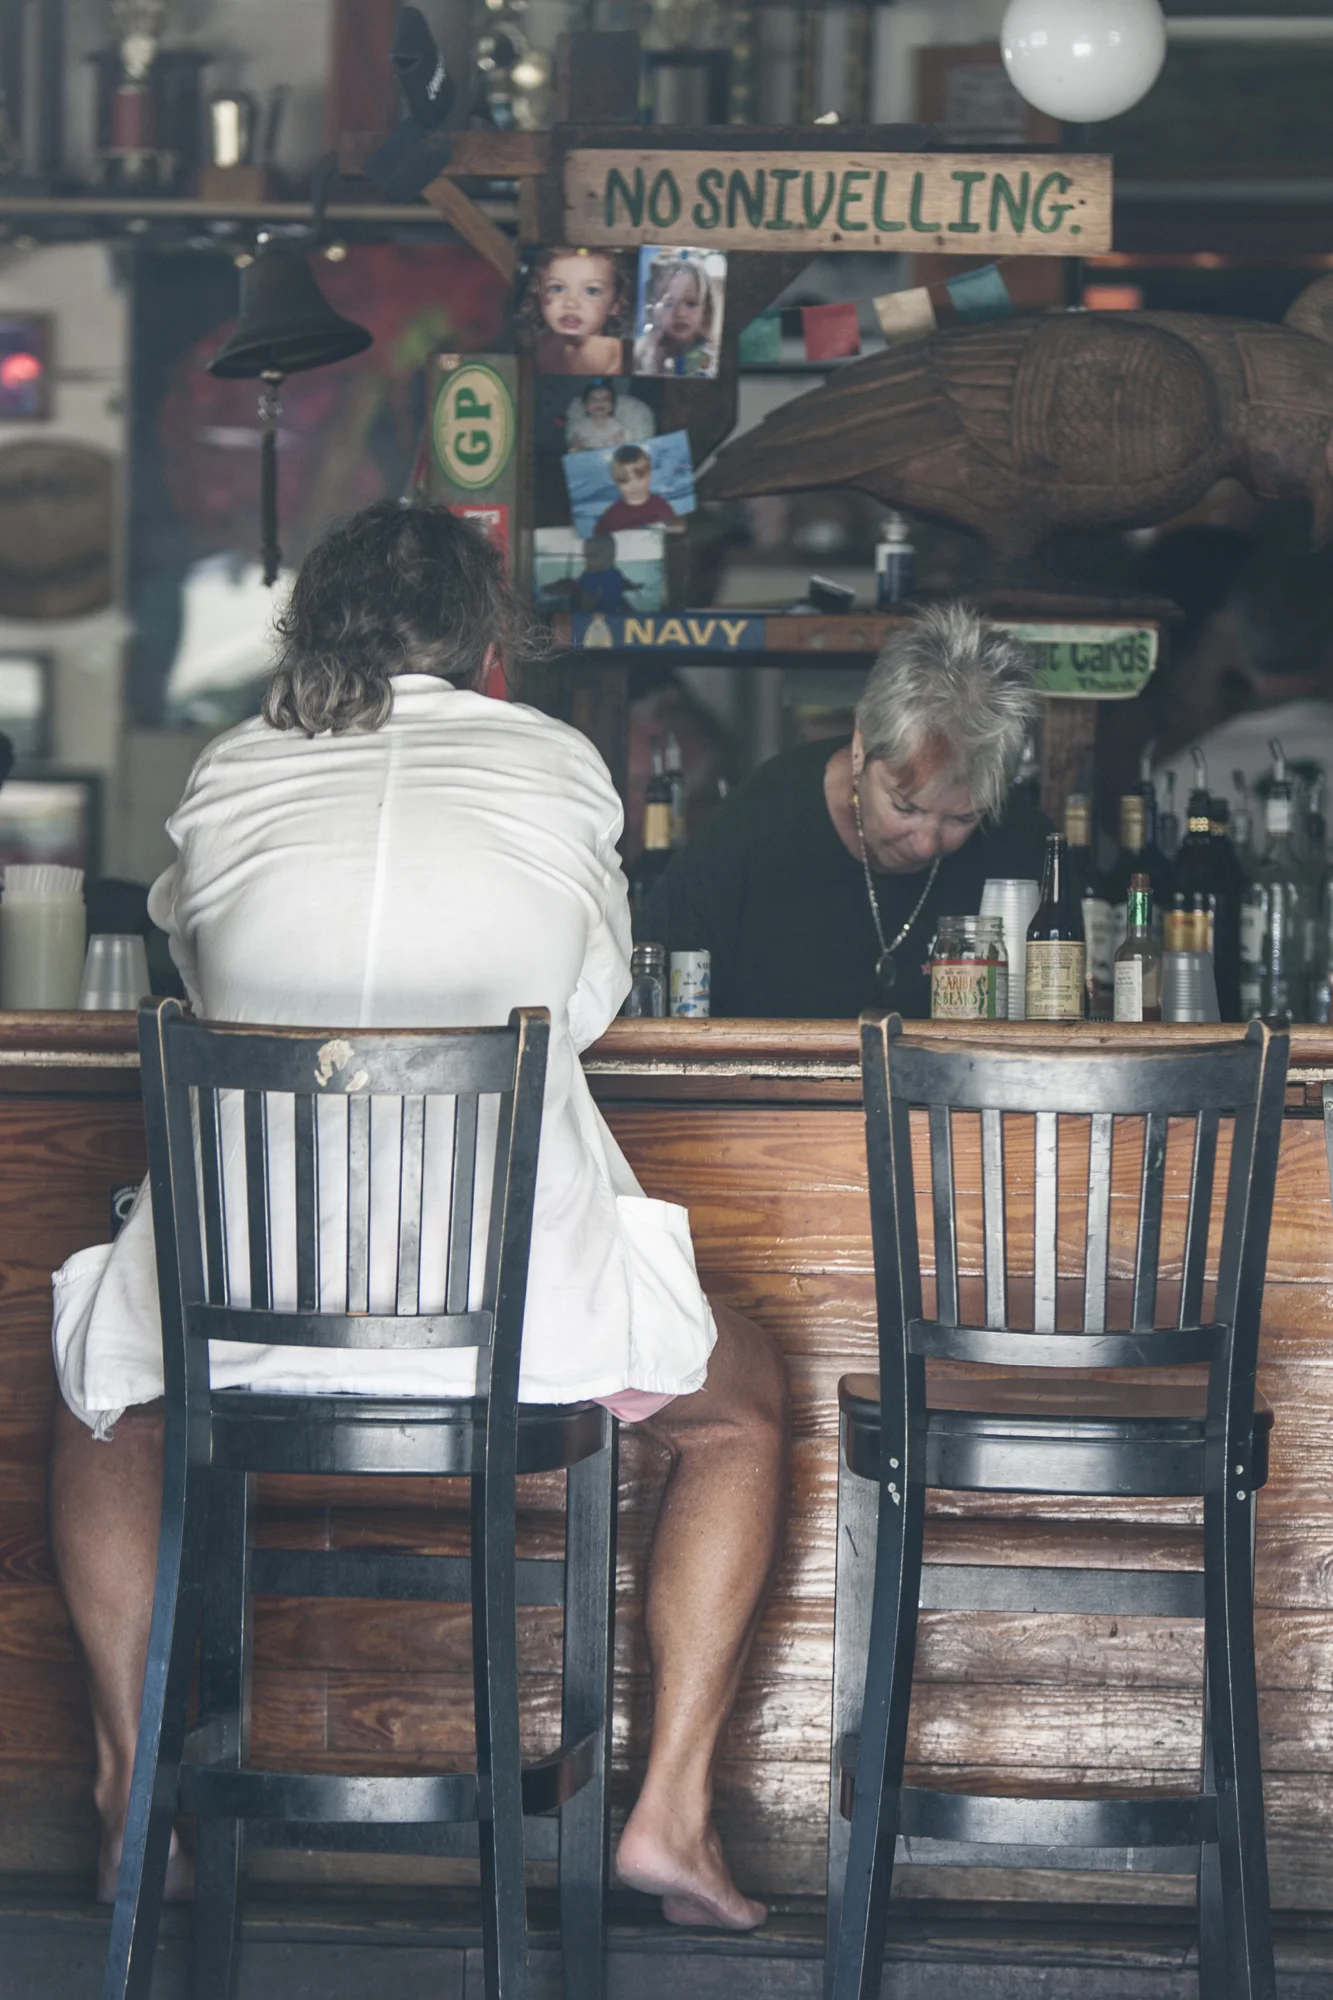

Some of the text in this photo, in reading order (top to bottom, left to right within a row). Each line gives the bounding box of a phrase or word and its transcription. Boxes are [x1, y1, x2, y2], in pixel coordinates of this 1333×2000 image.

[605, 167, 681, 228] NO
[455, 387, 492, 466] GP
[623, 617, 749, 647] NAVY
[1071, 634, 1149, 673] Cards
